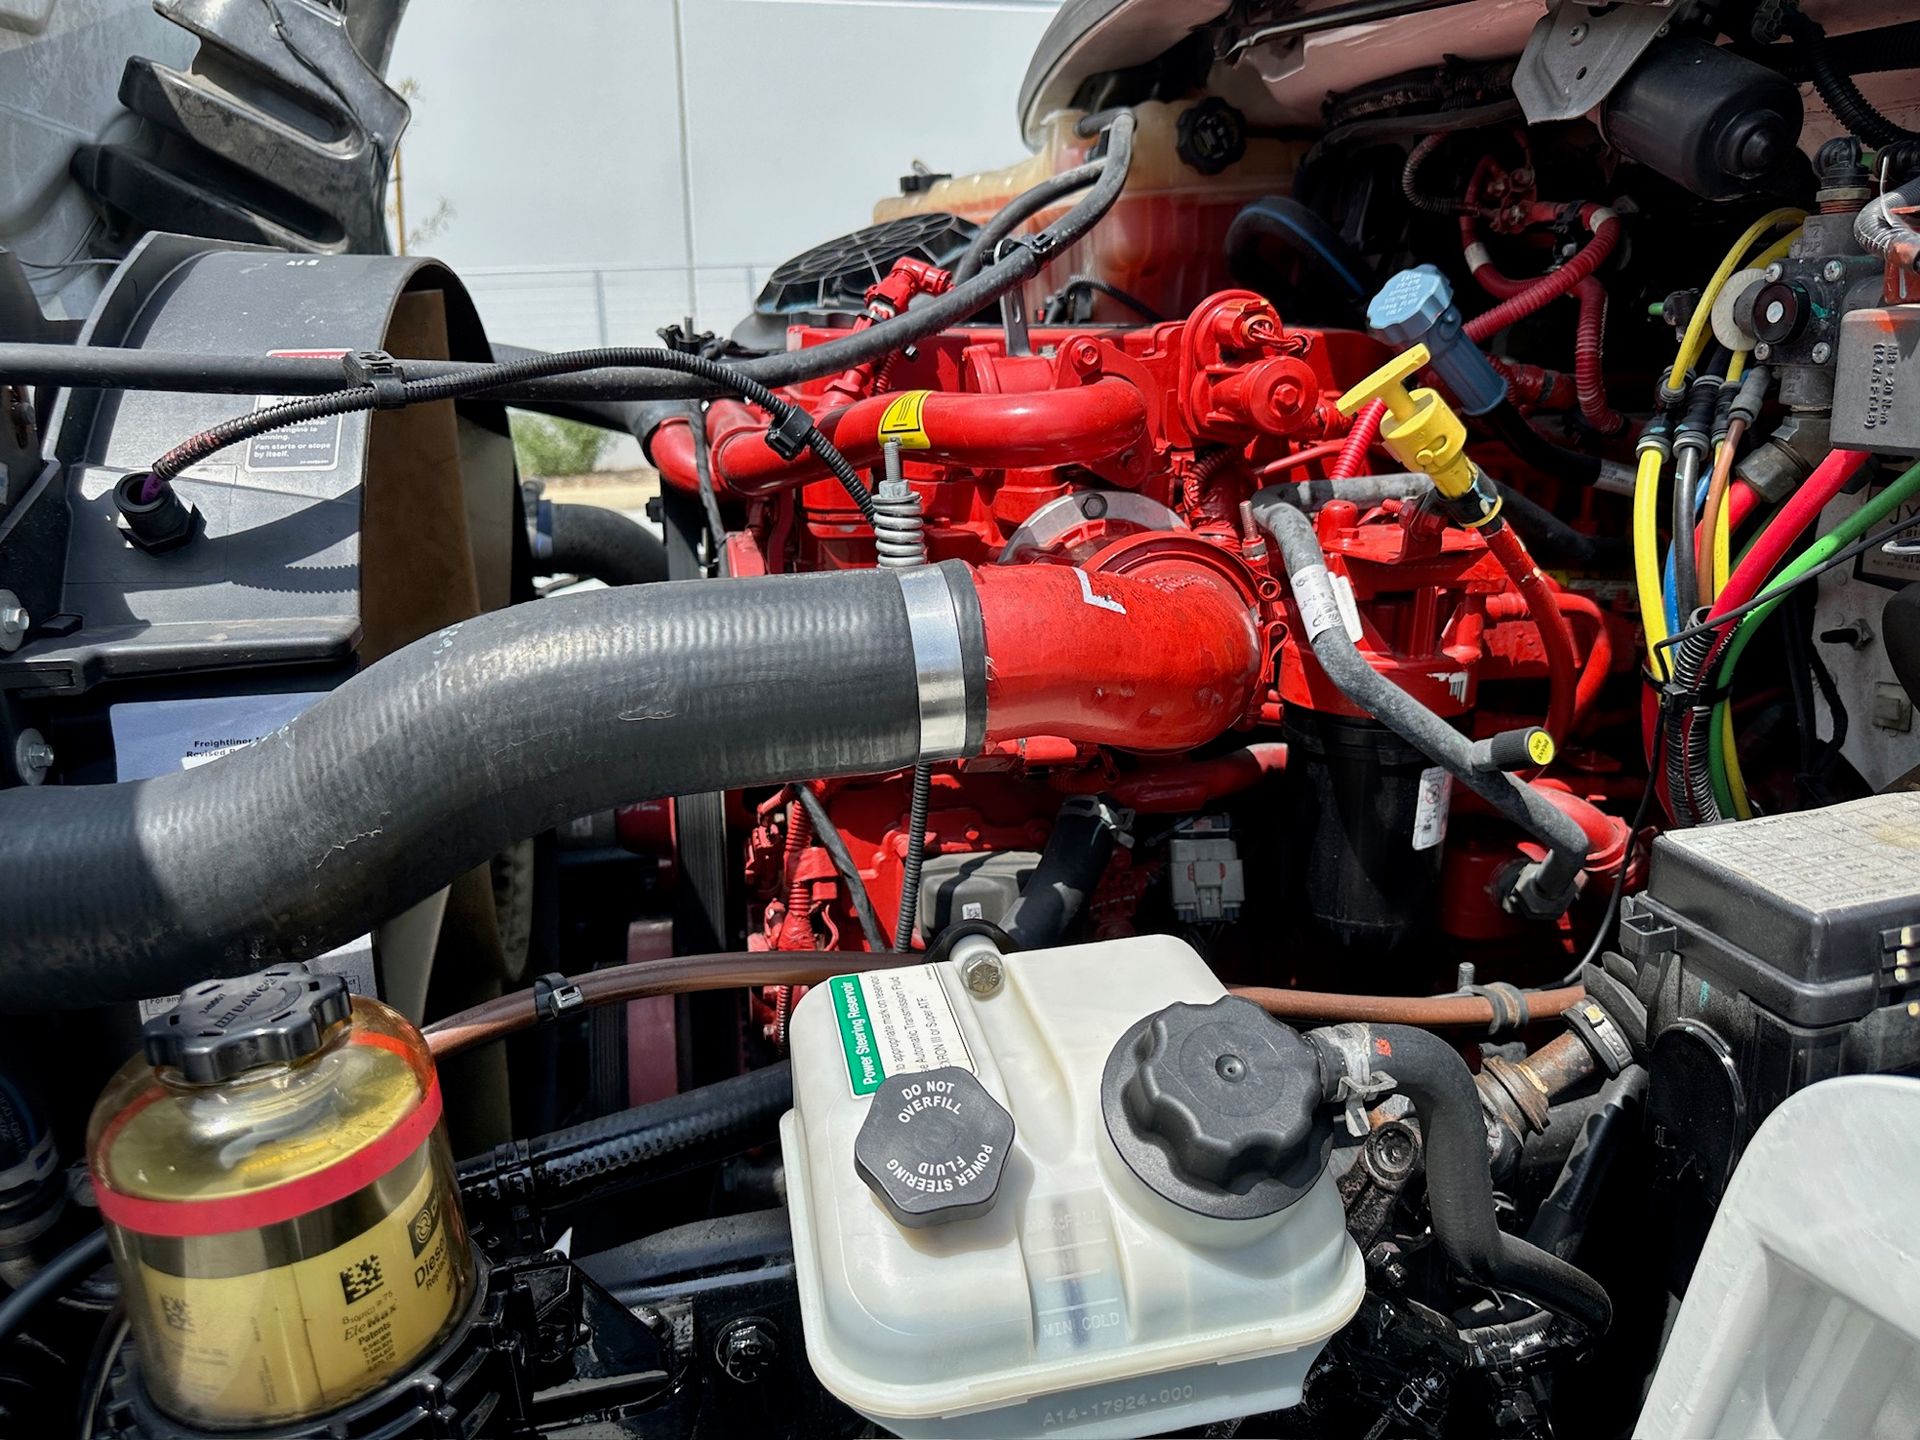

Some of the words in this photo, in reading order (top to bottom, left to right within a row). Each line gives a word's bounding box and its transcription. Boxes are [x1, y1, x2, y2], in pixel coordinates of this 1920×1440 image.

[253, 450, 265, 459] by
[869, 974, 886, 1000] reservoir
[889, 974, 902, 991] Fluid
[840, 981, 862, 1019] Reservoir
[877, 999, 888, 1010] on
[894, 989, 917, 1031] Transmission
[878, 1008, 892, 1026] mark
[923, 1009, 938, 1029] Super
[850, 1017, 871, 1056] Steering
[884, 1024, 906, 1064] appropriate
[908, 1029, 927, 1063] Automatic
[862, 1055, 878, 1086] Power
[901, 1083, 922, 1101] DO
[926, 1080, 956, 1095] NOT
[897, 1095, 962, 1124] OVERFILL
[886, 1158, 954, 1193] STEERING
[917, 1155, 967, 1176] FLUID
[957, 1143, 994, 1187] POWER
[358, 1321, 392, 1346] Patents
[1041, 1319, 1074, 1338] MIN
[1081, 1311, 1121, 1332] COLD
[1042, 1384, 1194, 1427] A14-17924-000
